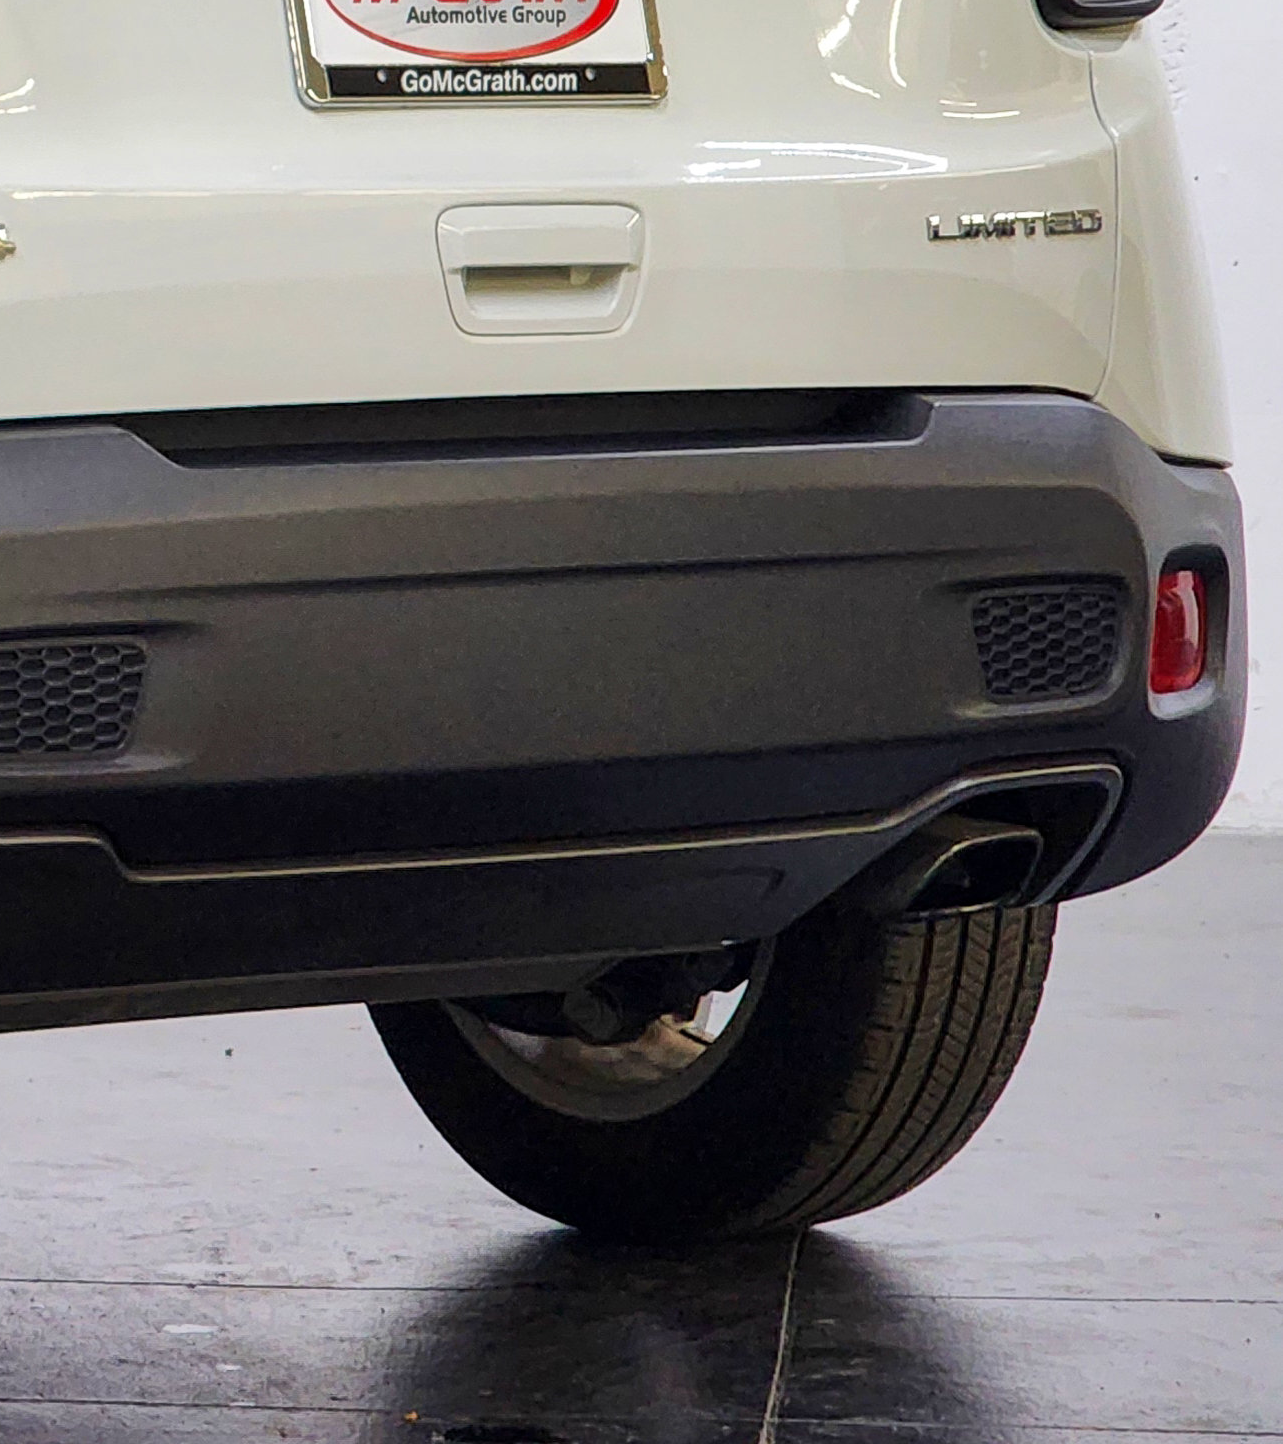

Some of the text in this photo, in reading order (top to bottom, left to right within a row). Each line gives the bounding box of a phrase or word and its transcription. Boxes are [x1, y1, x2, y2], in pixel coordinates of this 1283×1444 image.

[406, 5, 567, 27] Automotive Group
[400, 68, 578, 93] GoMcGrath.com
[925, 209, 1103, 242] LIMITED
